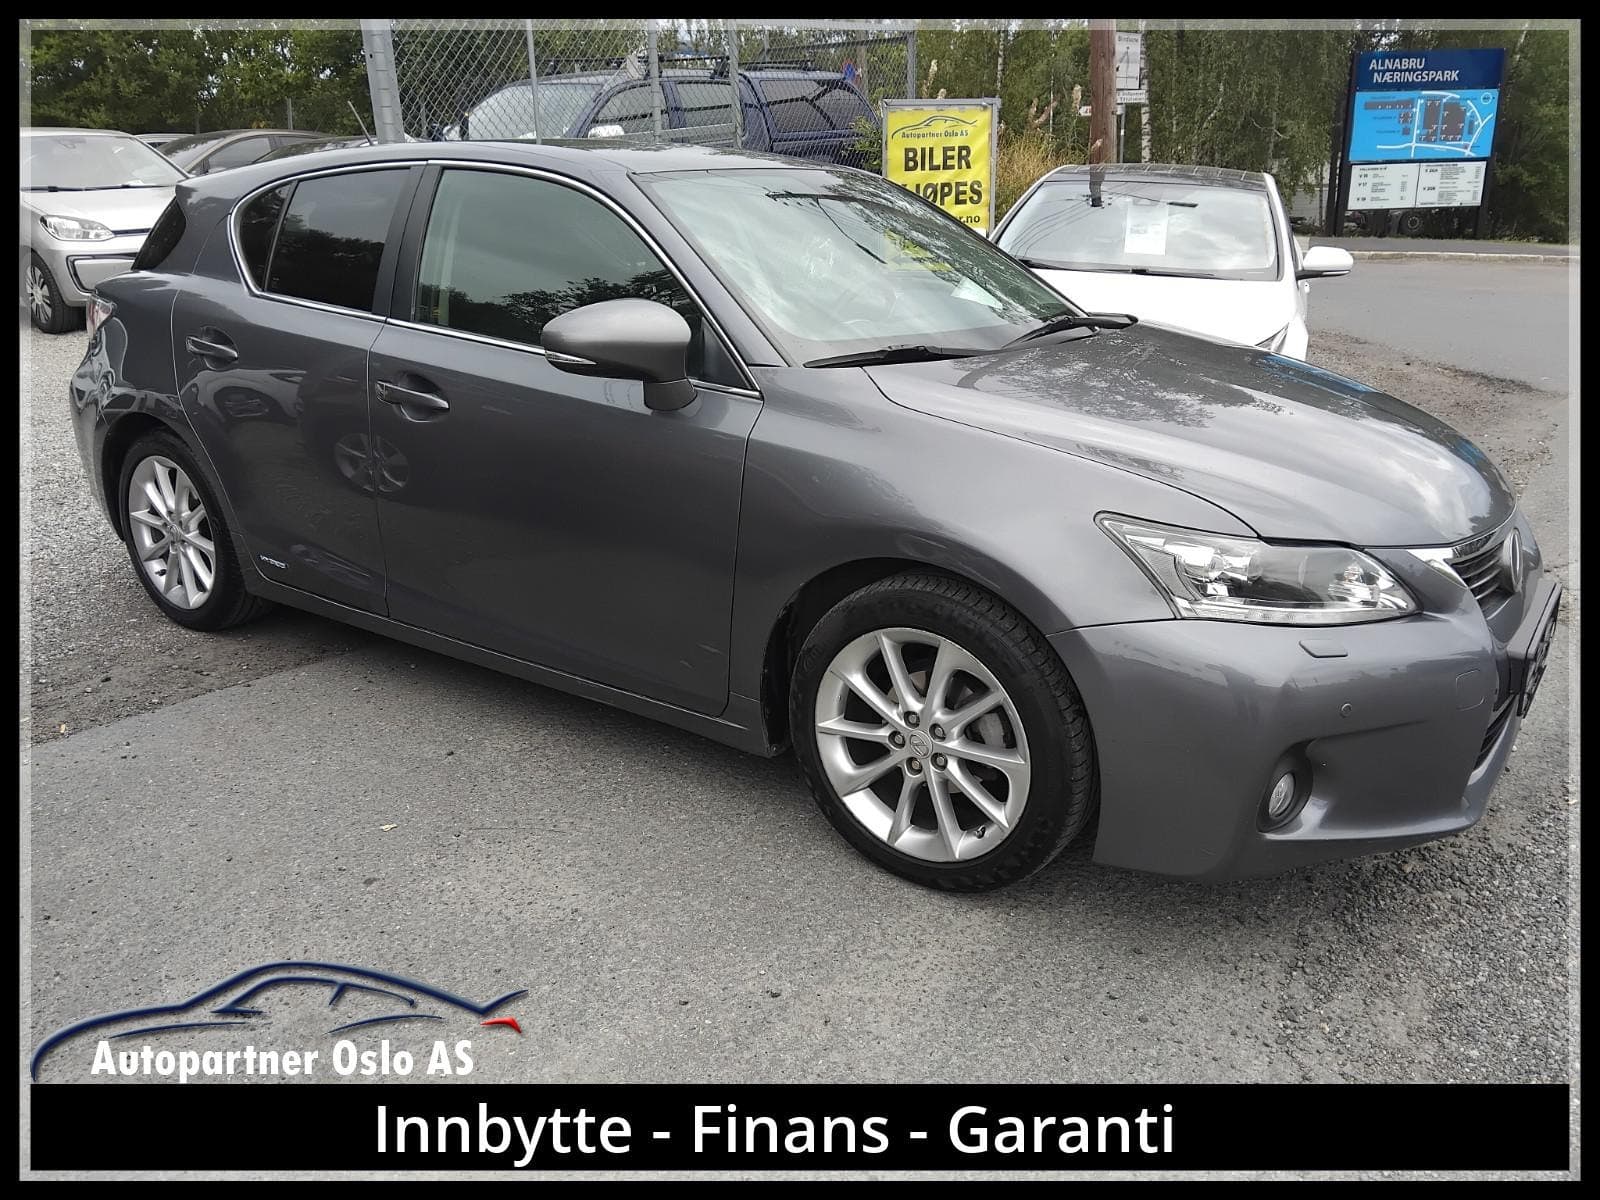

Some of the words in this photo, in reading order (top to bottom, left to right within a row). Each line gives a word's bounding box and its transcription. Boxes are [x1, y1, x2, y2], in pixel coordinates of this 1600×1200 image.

[1369, 58, 1425, 70] ALNABRU
[1373, 70, 1460, 83] NÆRINGSPARK
[901, 131, 942, 139] Autopartner
[944, 130, 958, 138] Oslo
[904, 145, 971, 172] BILER
[901, 180, 983, 206] ØPES
